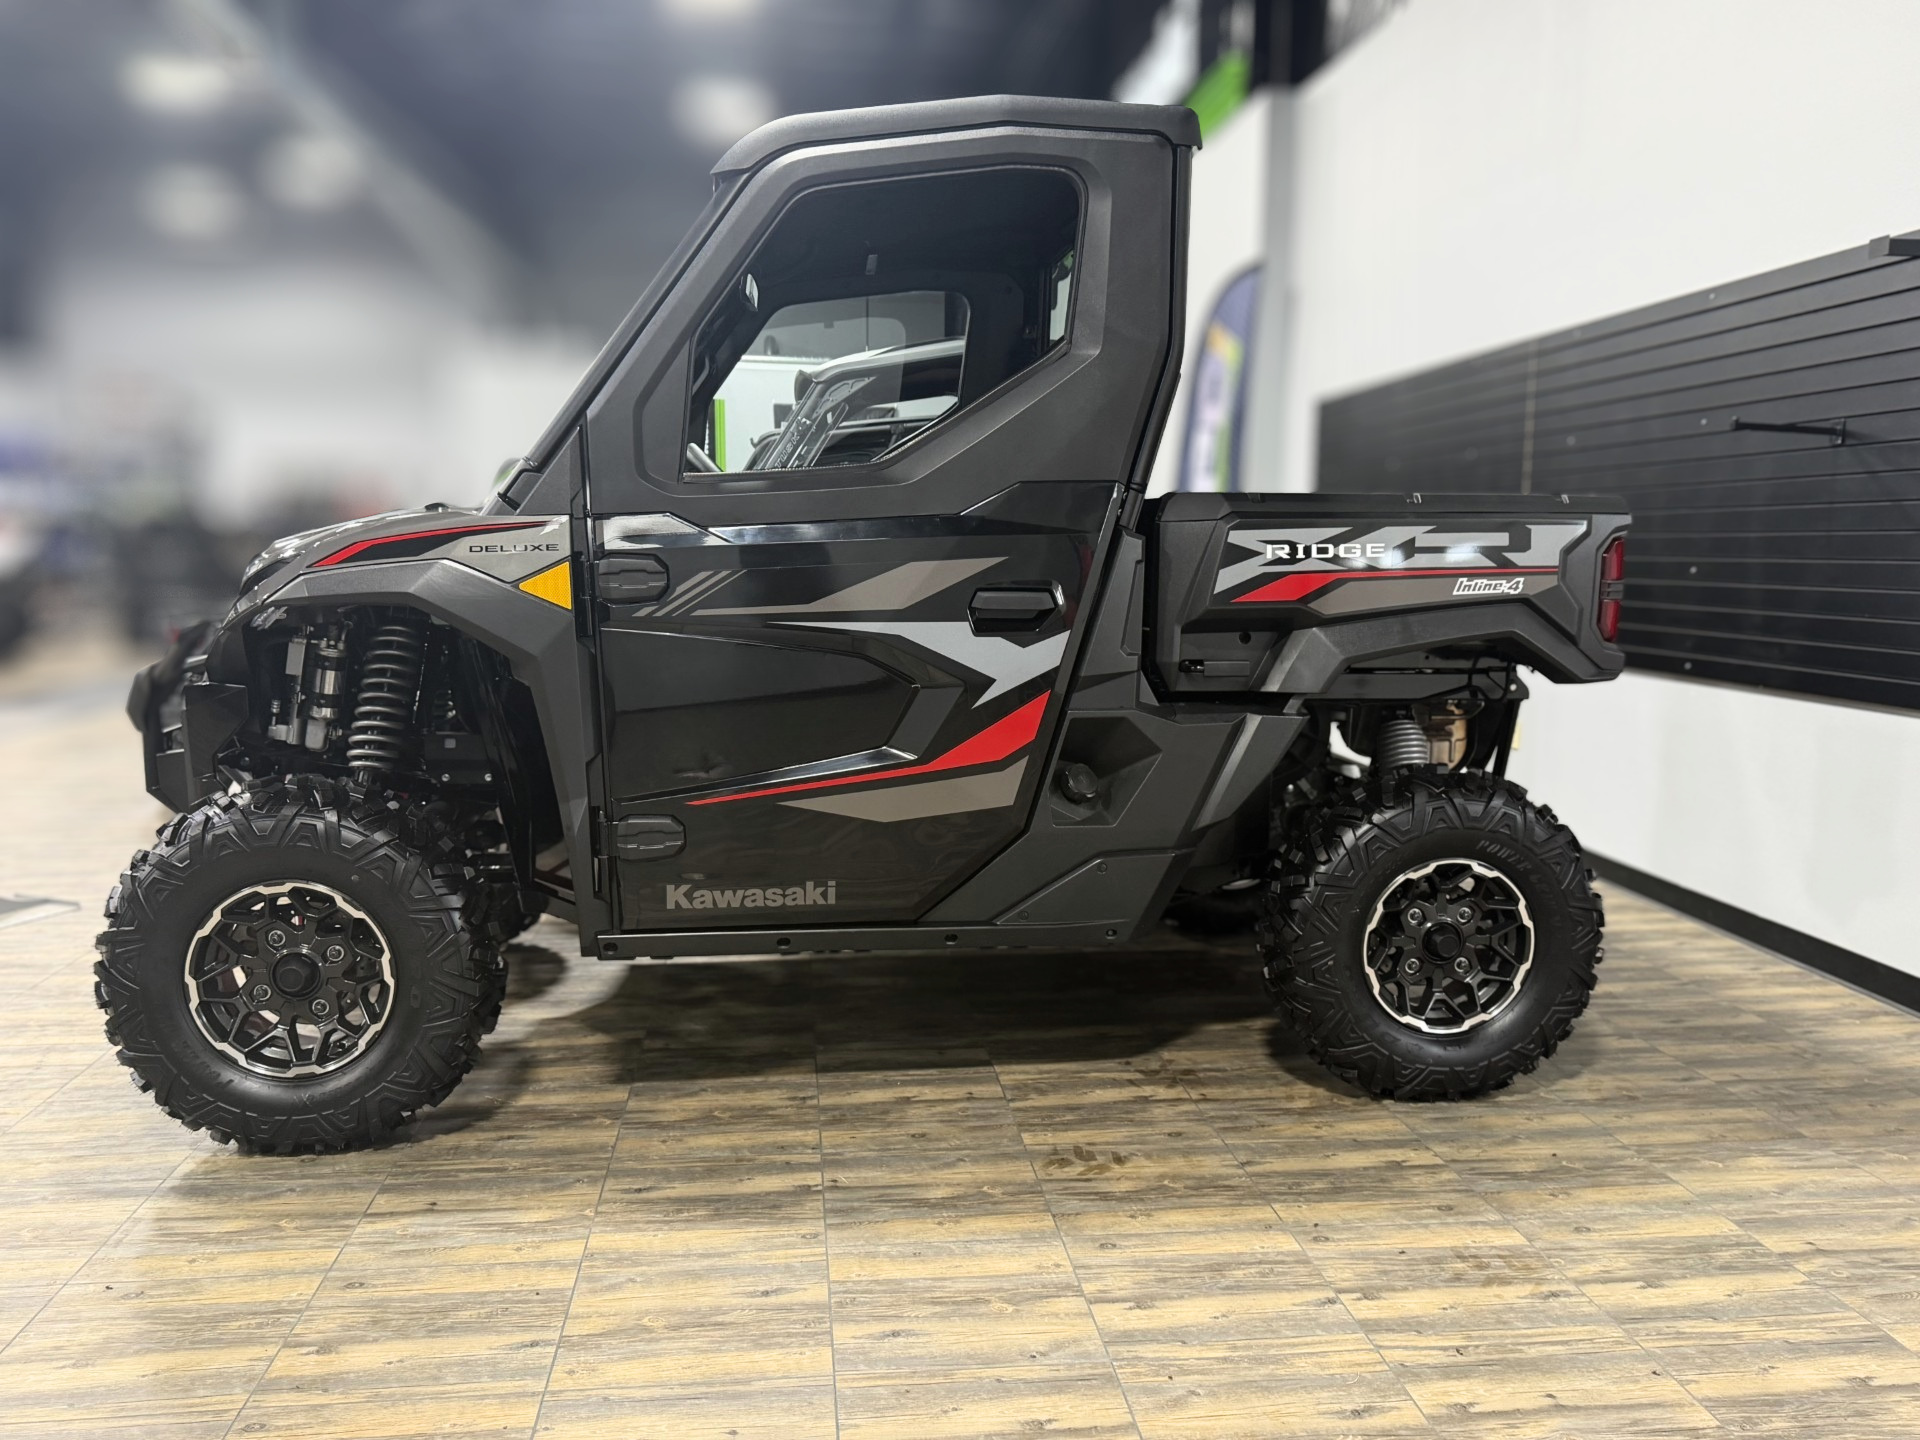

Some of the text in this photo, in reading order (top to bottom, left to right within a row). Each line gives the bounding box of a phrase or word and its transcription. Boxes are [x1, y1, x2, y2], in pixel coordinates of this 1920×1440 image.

[468, 543, 560, 554] DELUXE
[1265, 543, 1386, 560] RIDGE
[1452, 577, 1525, 596] Inline-4
[666, 880, 836, 910] Kawasaki
